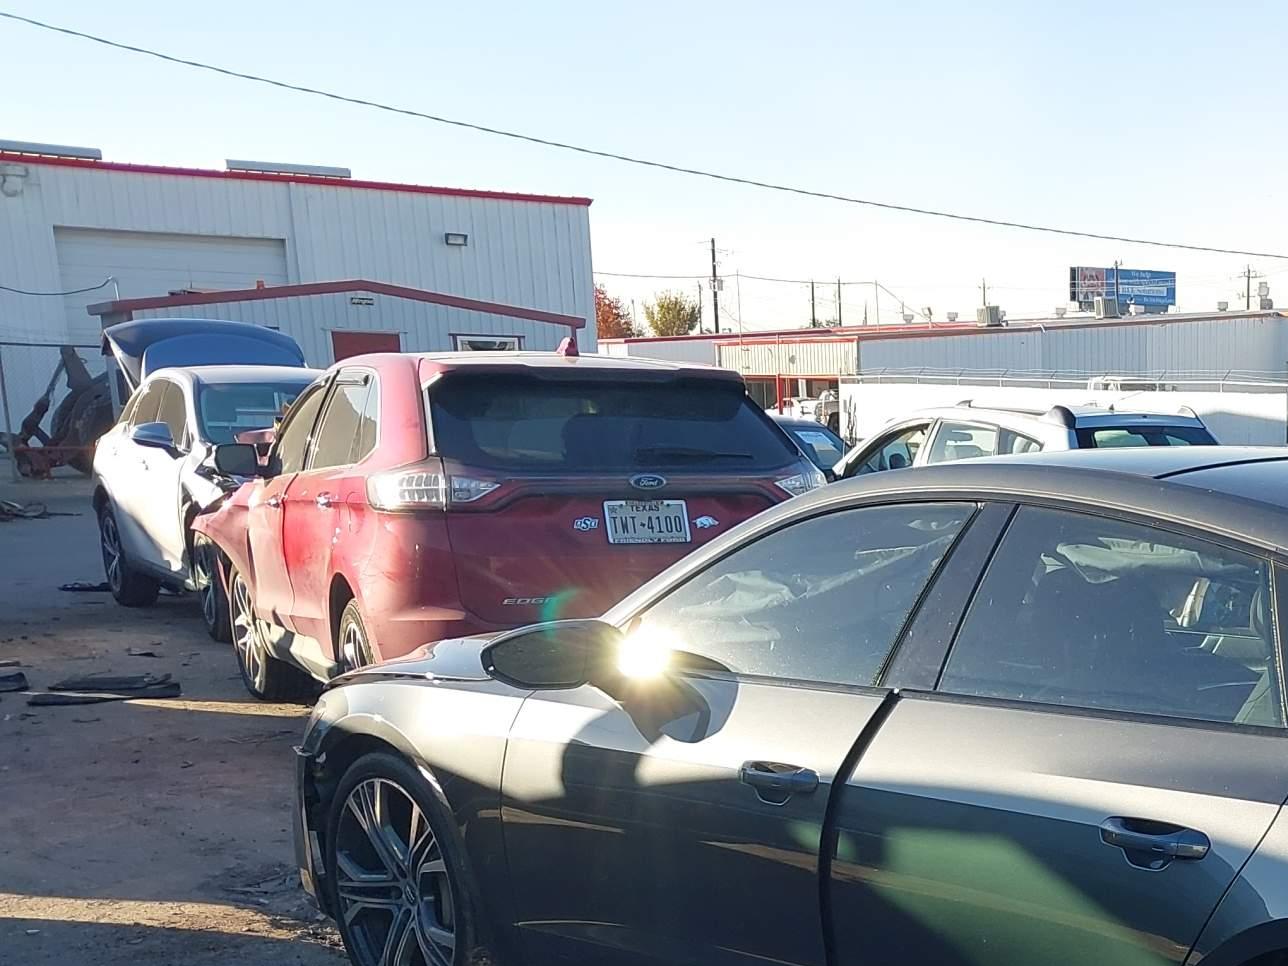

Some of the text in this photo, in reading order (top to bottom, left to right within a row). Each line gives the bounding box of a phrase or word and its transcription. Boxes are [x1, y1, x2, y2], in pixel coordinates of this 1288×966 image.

[639, 477, 658, 487] Ford
[630, 503, 660, 513] TEXAS
[647, 515, 683, 534] 4100
